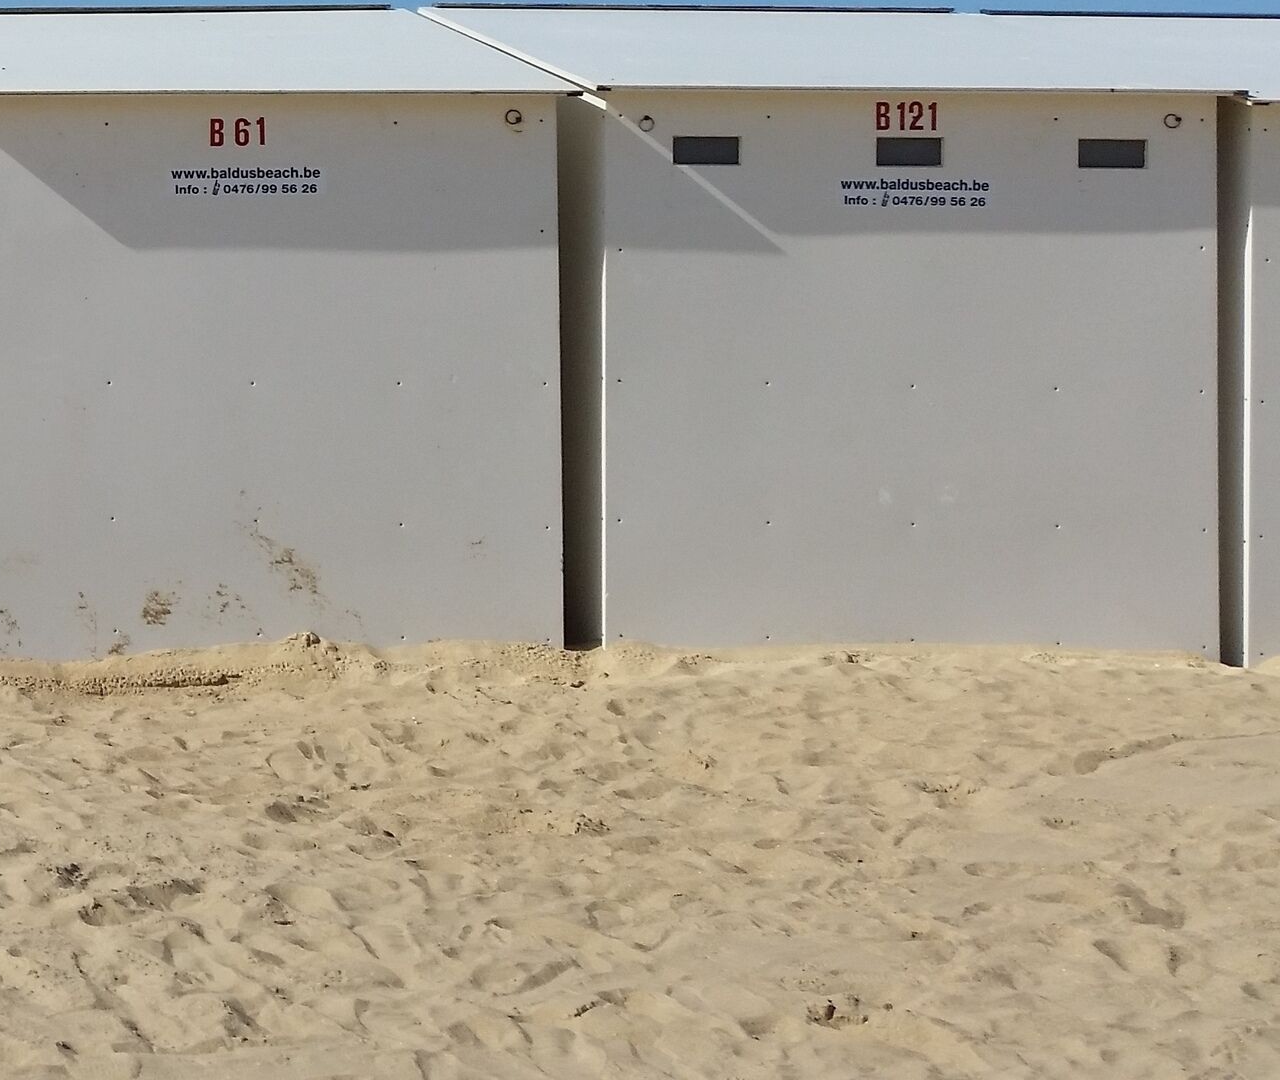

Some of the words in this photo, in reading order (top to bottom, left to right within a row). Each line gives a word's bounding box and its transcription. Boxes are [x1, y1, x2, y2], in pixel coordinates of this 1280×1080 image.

[171, 166, 321, 180] www.baldusbeach.be
[175, 184, 200, 195] Info
[223, 184, 278, 194] 0476/99
[281, 184, 298, 194] 56
[301, 184, 318, 194] 26
[840, 178, 990, 192] www.baldusbeach.be
[844, 195, 869, 206] Info
[892, 196, 947, 207] 0476/99
[950, 196, 967, 207] 56
[970, 196, 987, 208] 26
